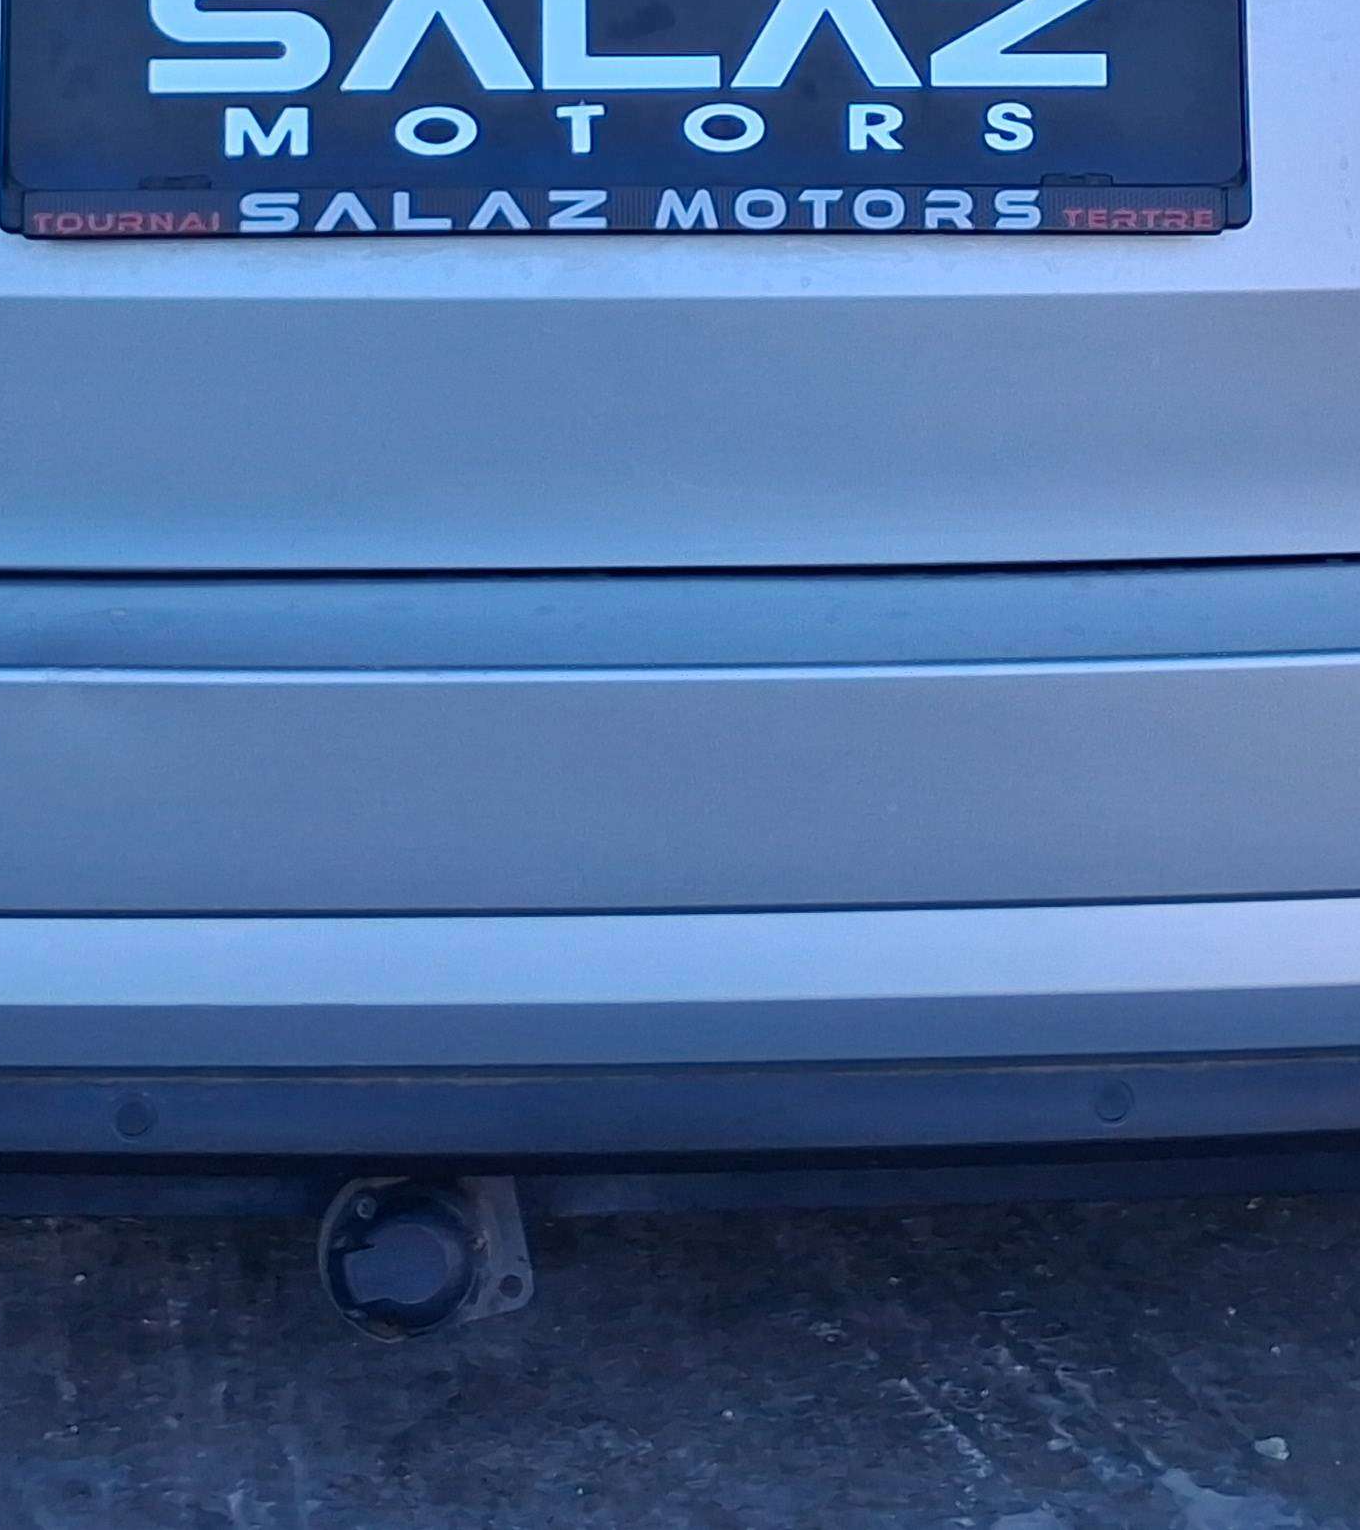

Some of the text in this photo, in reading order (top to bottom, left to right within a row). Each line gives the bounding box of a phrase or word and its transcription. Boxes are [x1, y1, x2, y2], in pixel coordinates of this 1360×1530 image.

[224, 101, 1035, 157] MOTORS
[32, 188, 1214, 233] TOURNAI SALAZ MOTORS TERTRE
